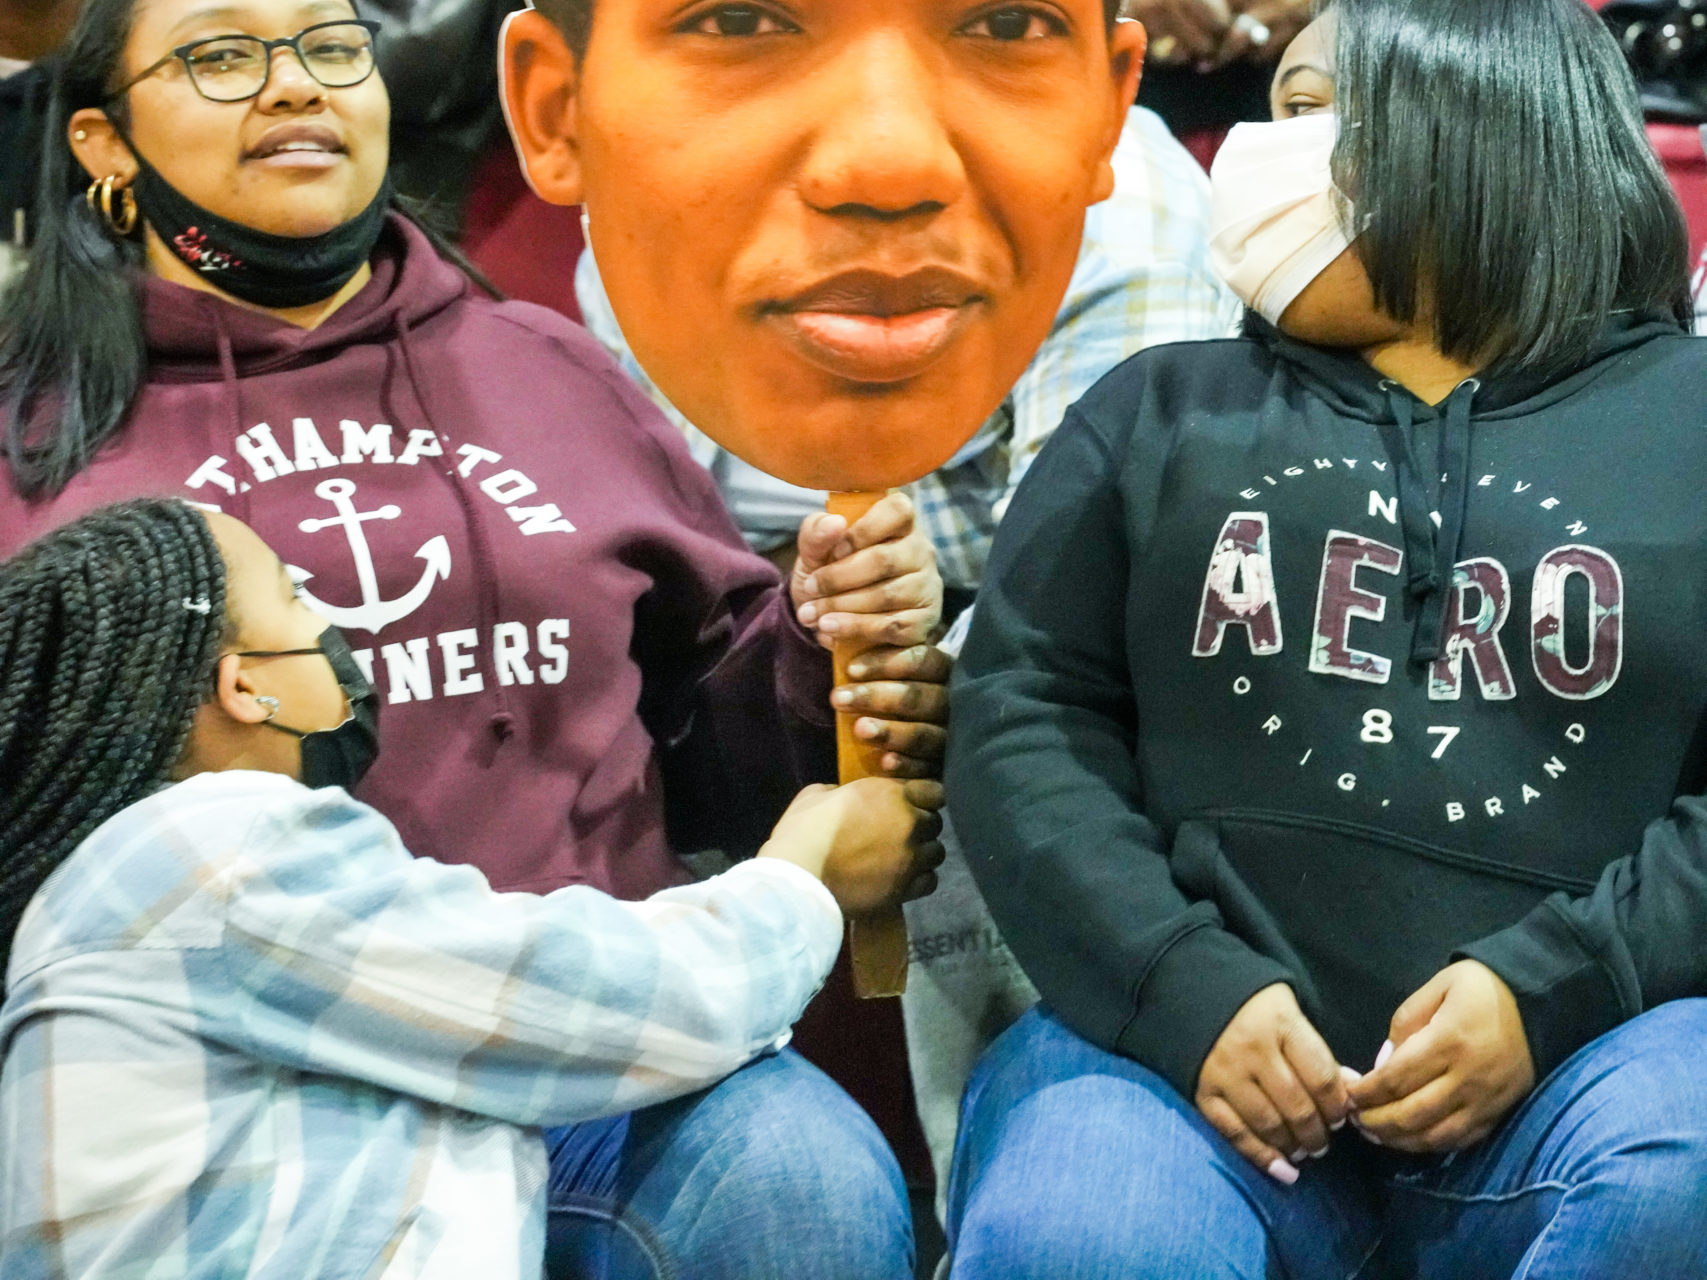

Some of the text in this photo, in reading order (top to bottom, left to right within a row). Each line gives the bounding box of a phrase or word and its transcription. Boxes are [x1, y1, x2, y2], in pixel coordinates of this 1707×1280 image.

[181, 418, 577, 536] THAMPTON
[1440, 472, 1588, 536] EVEN
[1191, 511, 1624, 701] AERO
[1446, 722, 1587, 822] BRAND
